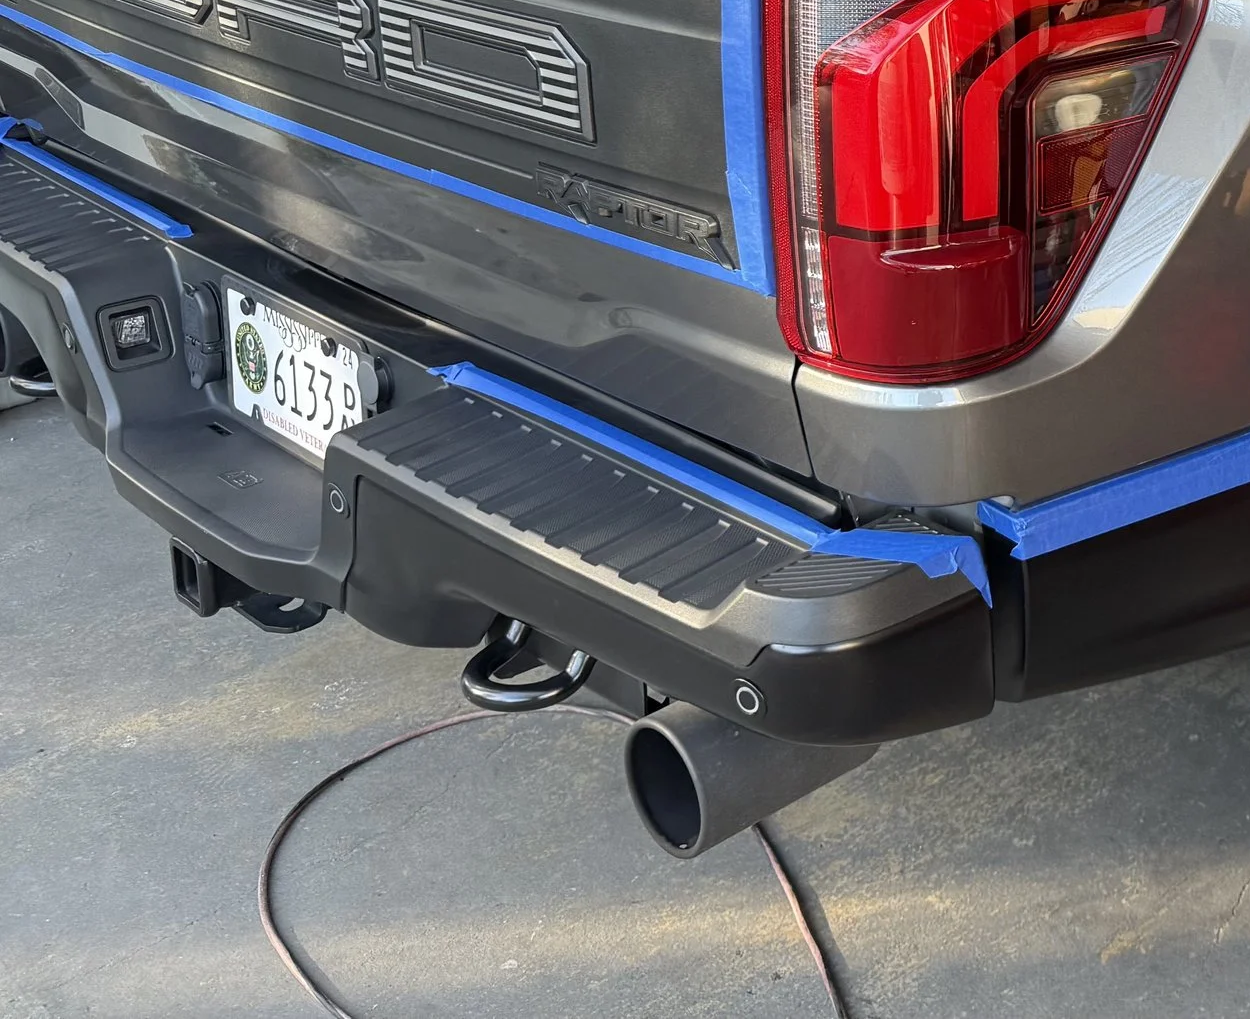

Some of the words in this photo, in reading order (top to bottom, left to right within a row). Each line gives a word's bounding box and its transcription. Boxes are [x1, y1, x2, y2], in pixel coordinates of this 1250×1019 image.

[536, 162, 740, 272] RAPTOR
[262, 306, 321, 353] MISSISSIPP
[342, 346, 354, 369] 24
[274, 349, 335, 431] 6133
[262, 408, 299, 437] DISABLED
[299, 428, 327, 452] VETER
